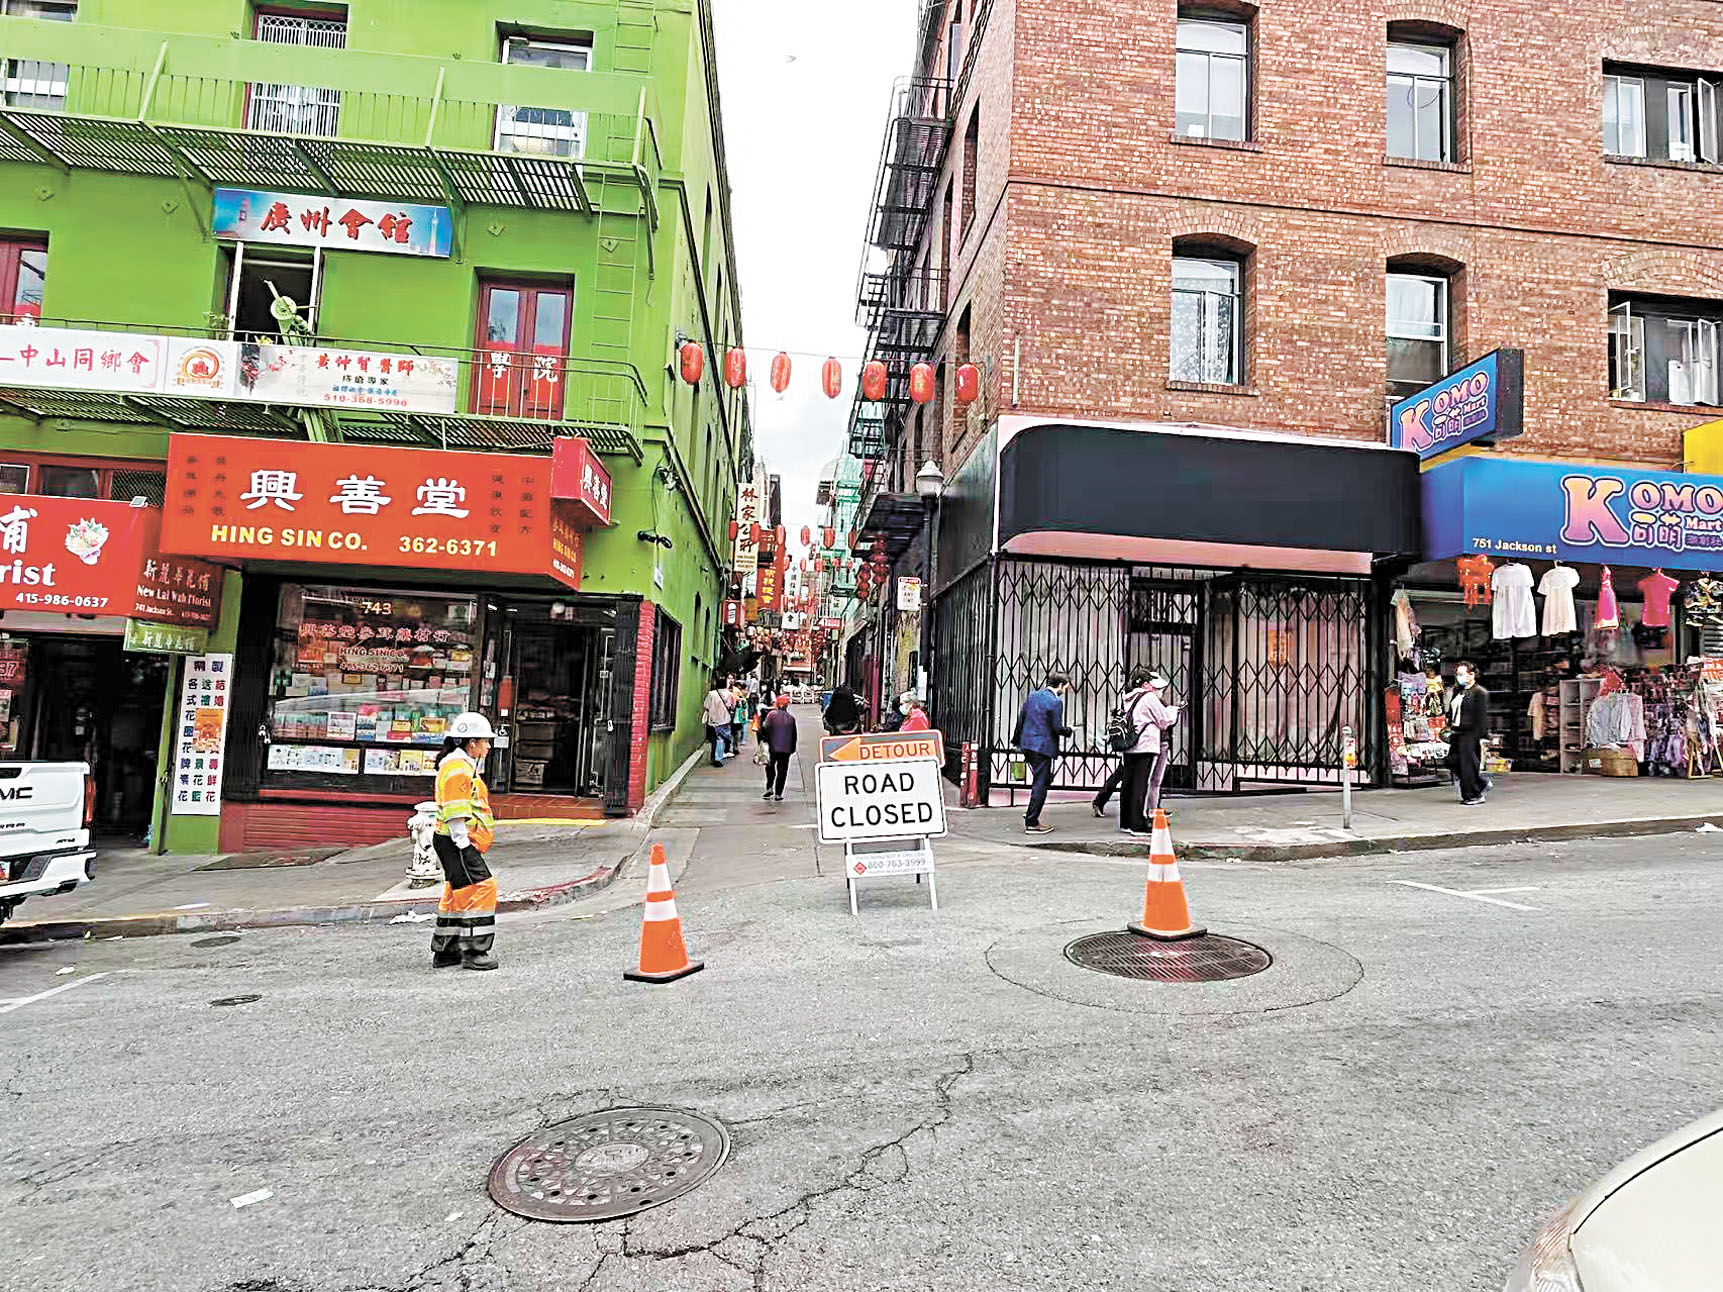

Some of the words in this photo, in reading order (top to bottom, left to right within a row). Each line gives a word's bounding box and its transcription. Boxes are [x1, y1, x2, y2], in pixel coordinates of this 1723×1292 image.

[261, 202, 413, 243] 廣州會館
[1401, 372, 1488, 452] KOMO
[1462, 396, 1487, 416] Mart
[240, 470, 470, 519] 興善堂
[1561, 475, 1723, 546] KOMO
[1685, 516, 1723, 532] Mart
[211, 524, 273, 545] HING
[281, 529, 322, 548] SIN
[328, 531, 368, 551] CO.
[399, 536, 498, 557] 362-6371
[1472, 537, 1492, 549] 751
[1495, 540, 1542, 554] Jackson
[1545, 544, 1558, 554] st
[16, 592, 109, 608] 415-986-0637
[136, 584, 155, 598] New
[362, 602, 392, 615] 743
[859, 742, 931, 760] DETOUR
[844, 772, 915, 795] ROAD
[831, 802, 933, 828] CLOSED
